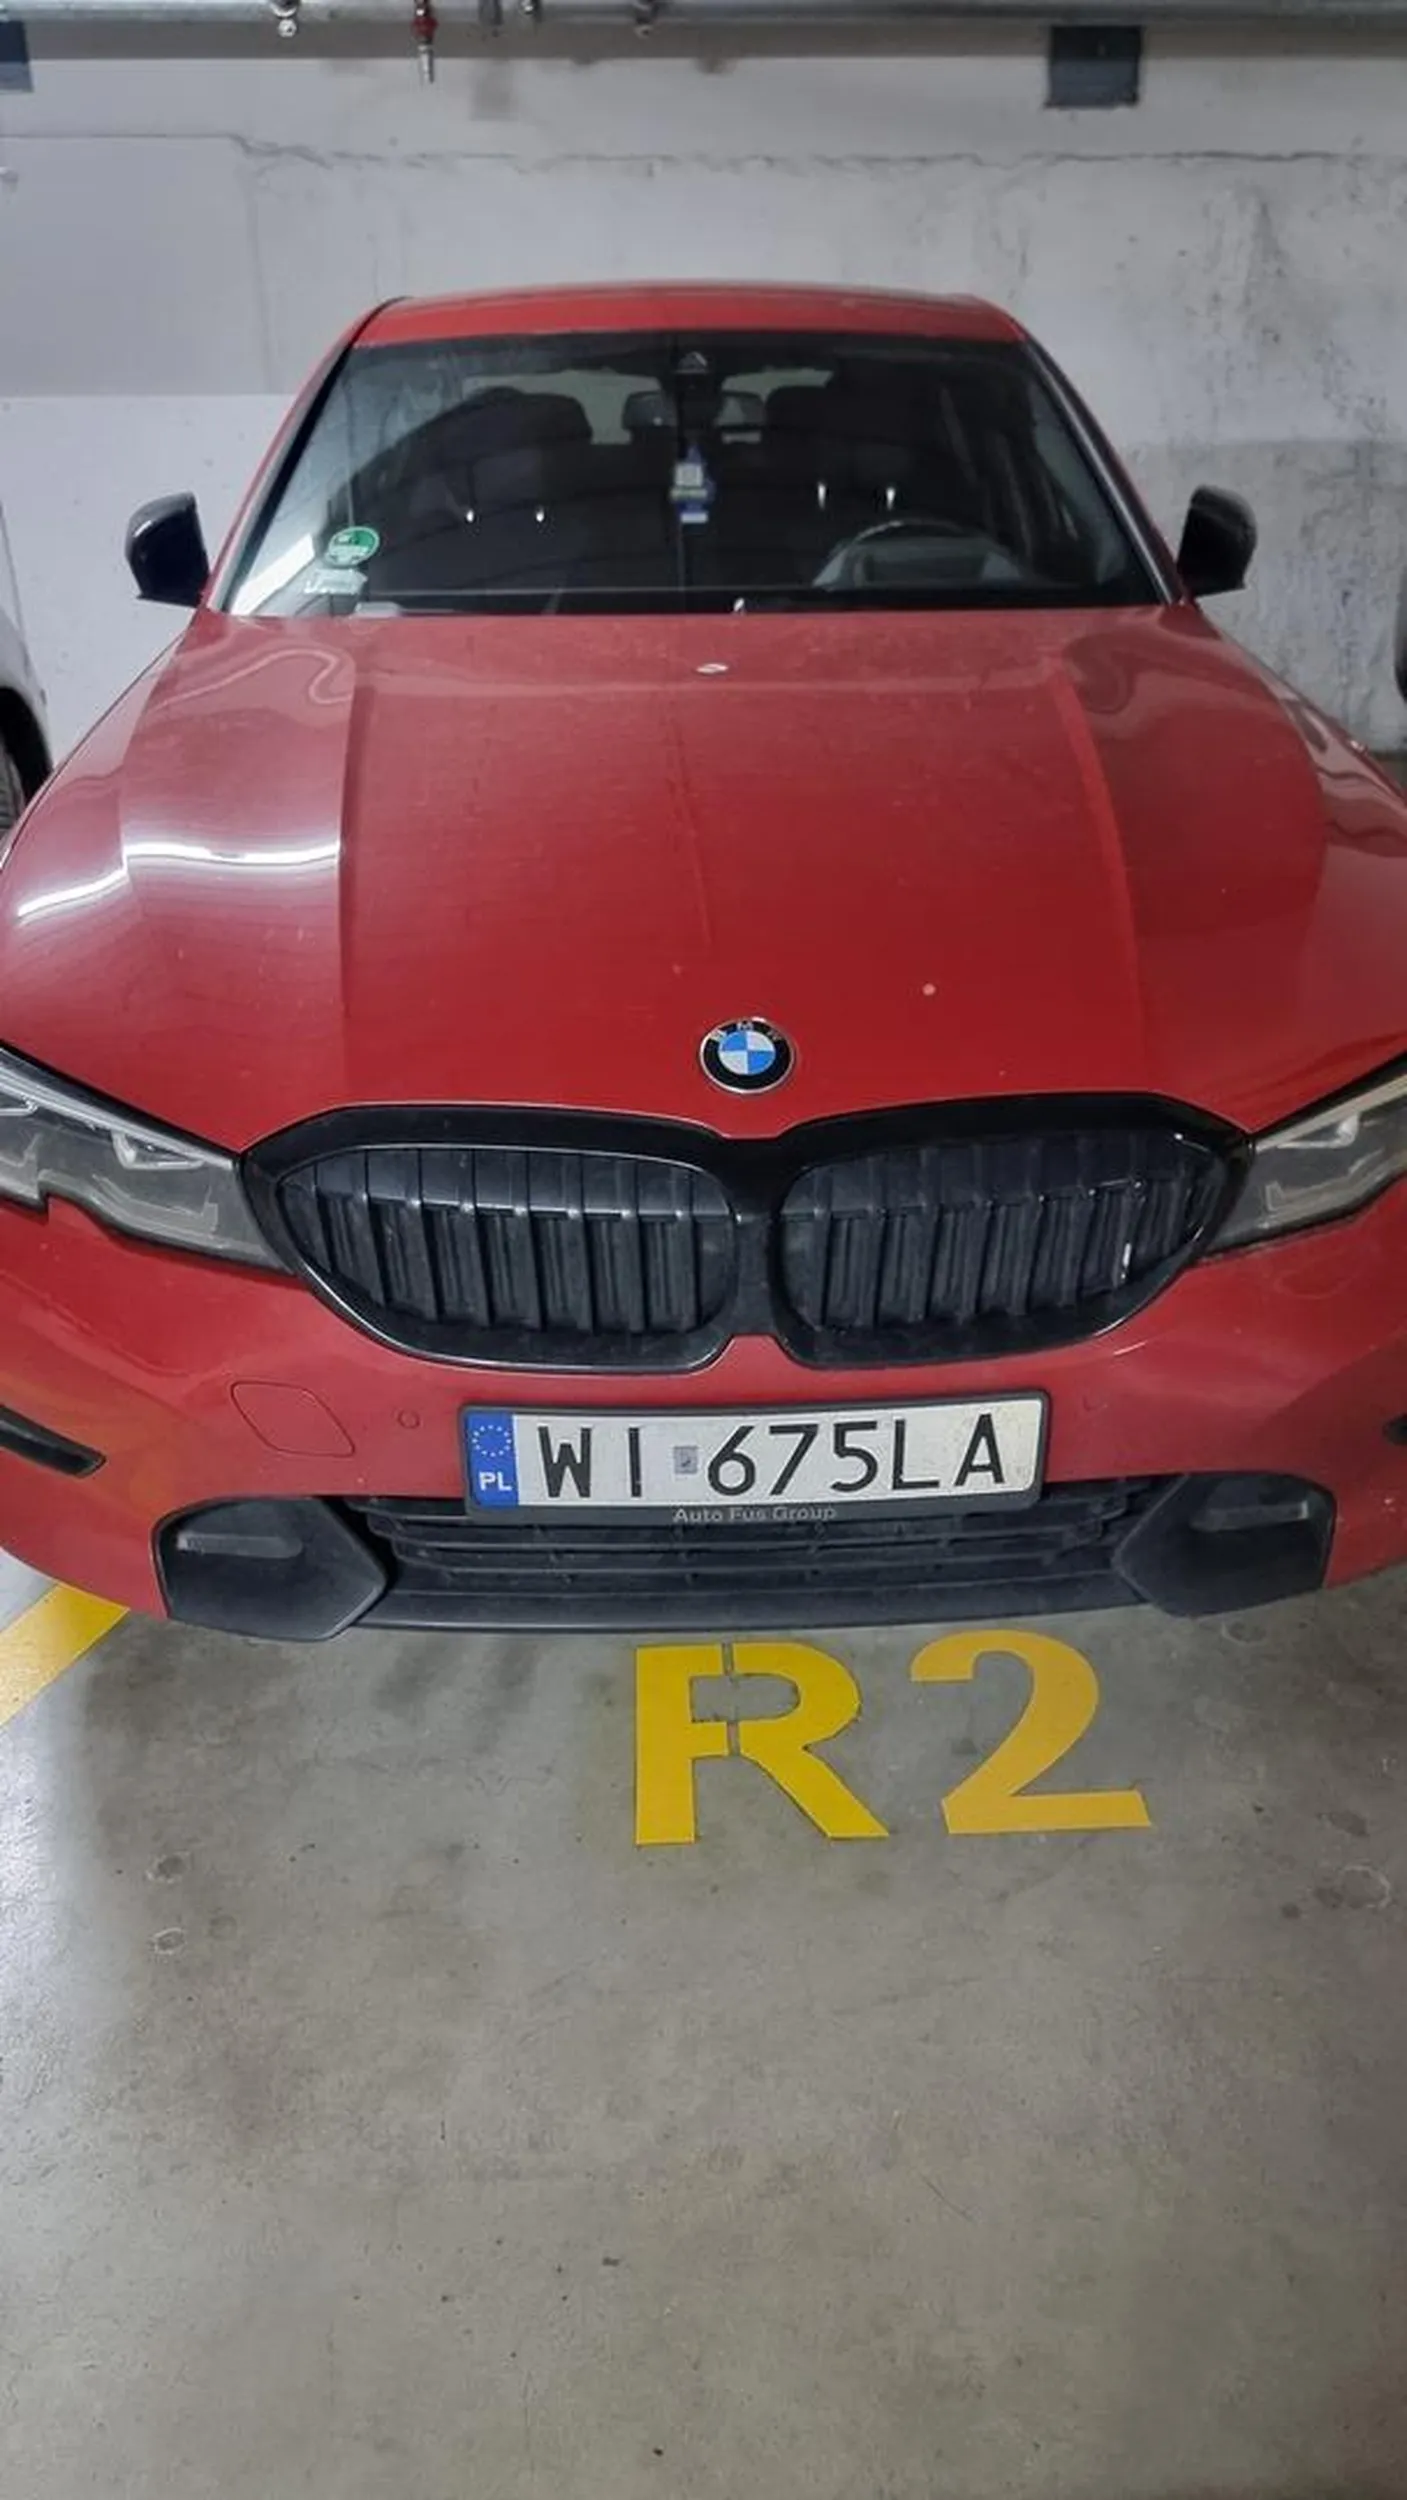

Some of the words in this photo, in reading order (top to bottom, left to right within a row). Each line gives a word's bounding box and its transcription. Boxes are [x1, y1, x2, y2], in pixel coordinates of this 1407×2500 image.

[537, 1425, 643, 1498] WI
[706, 1413, 1005, 1496] 675LA
[479, 1471, 513, 1492] PL
[673, 1508, 722, 1523] Auto
[730, 1507, 767, 1522] Fus
[772, 1505, 837, 1521] Group
